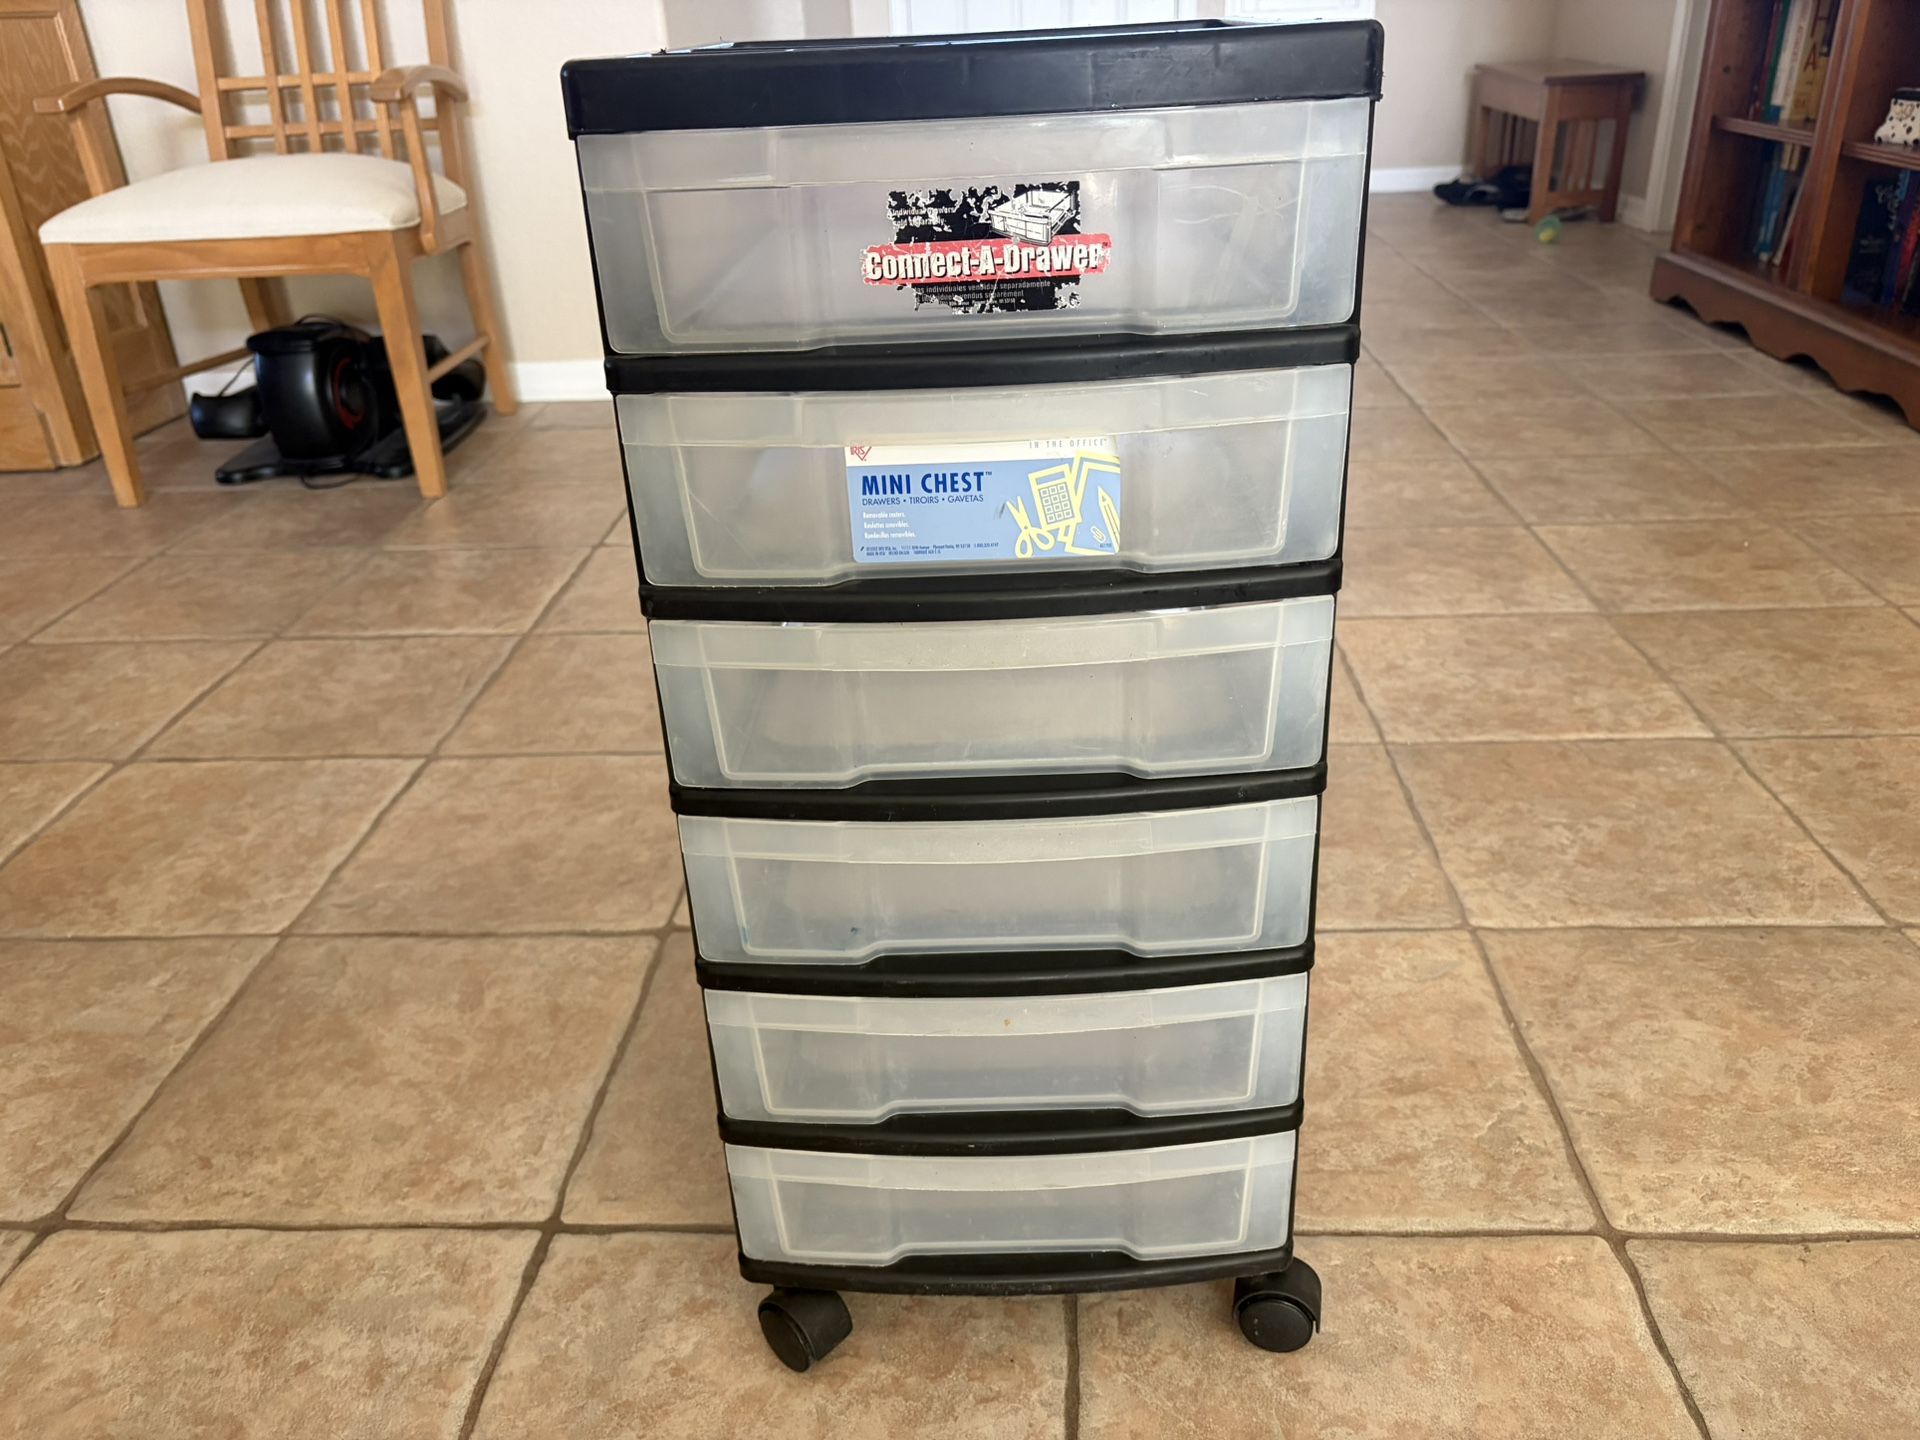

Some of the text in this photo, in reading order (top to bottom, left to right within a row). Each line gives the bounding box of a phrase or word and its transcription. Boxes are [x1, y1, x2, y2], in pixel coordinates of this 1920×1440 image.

[926, 284, 967, 293] individuales
[1000, 280, 1051, 290] separadamente
[1046, 440, 1062, 448] THE
[862, 474, 911, 496] MINI
[862, 494, 984, 506] DRAWERS TIROIRS GAVETAS
